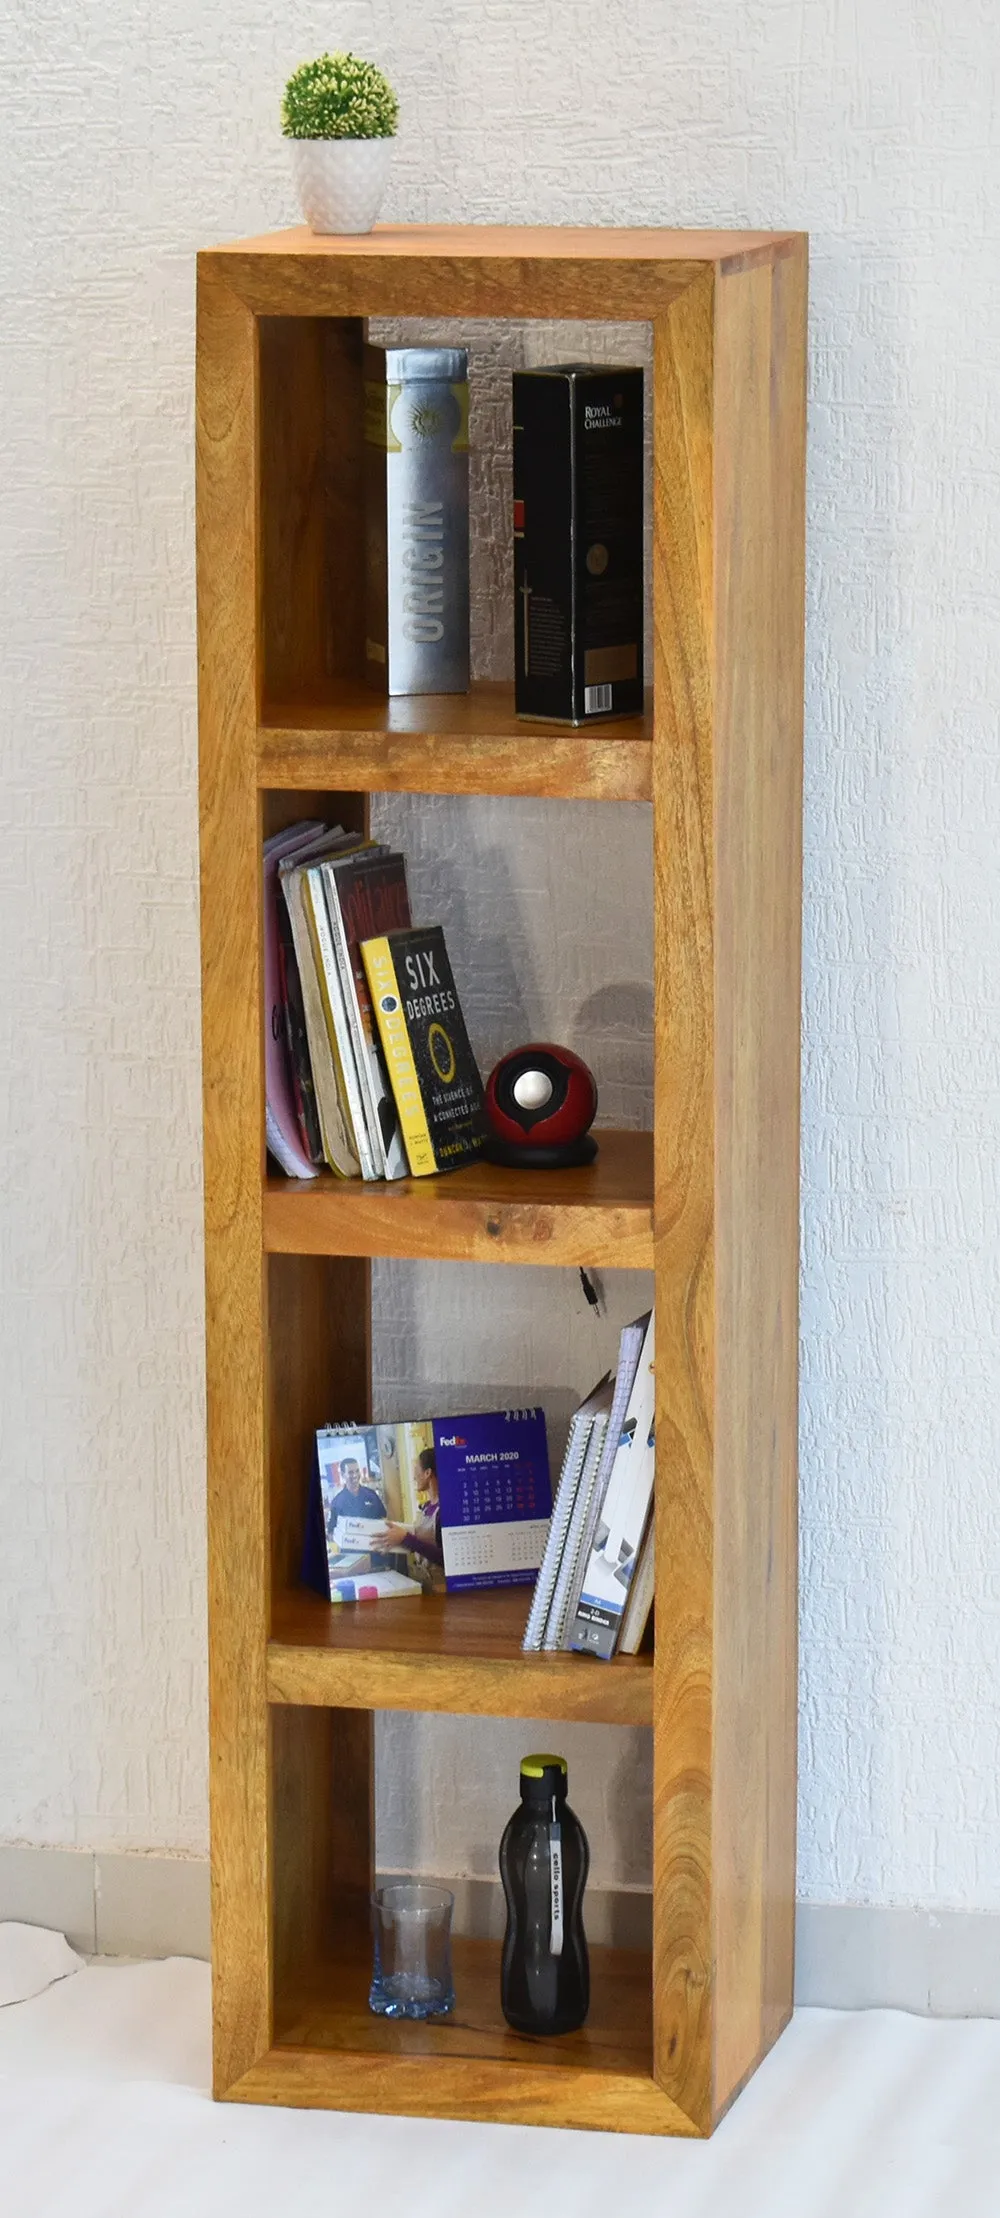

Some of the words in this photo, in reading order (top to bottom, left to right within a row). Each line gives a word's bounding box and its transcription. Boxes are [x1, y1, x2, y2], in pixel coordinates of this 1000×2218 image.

[584, 417, 622, 430] CHALLENGE
[585, 406, 610, 418] ROYAL
[402, 501, 444, 643] ORIGIN
[373, 955, 394, 992] SIX
[405, 950, 441, 991] SIX
[406, 990, 456, 1020] DEGREES
[385, 1019, 421, 1118] DEGREES
[432, 1094, 443, 1106] THE
[443, 1087, 466, 1103] SCIENCE
[438, 1104, 469, 1121] CONNECTED
[440, 1436, 467, 1447] FedEx
[466, 1454, 498, 1464] MARCH
[500, 1452, 519, 1461] 2020
[553, 1853, 561, 1881] cello
